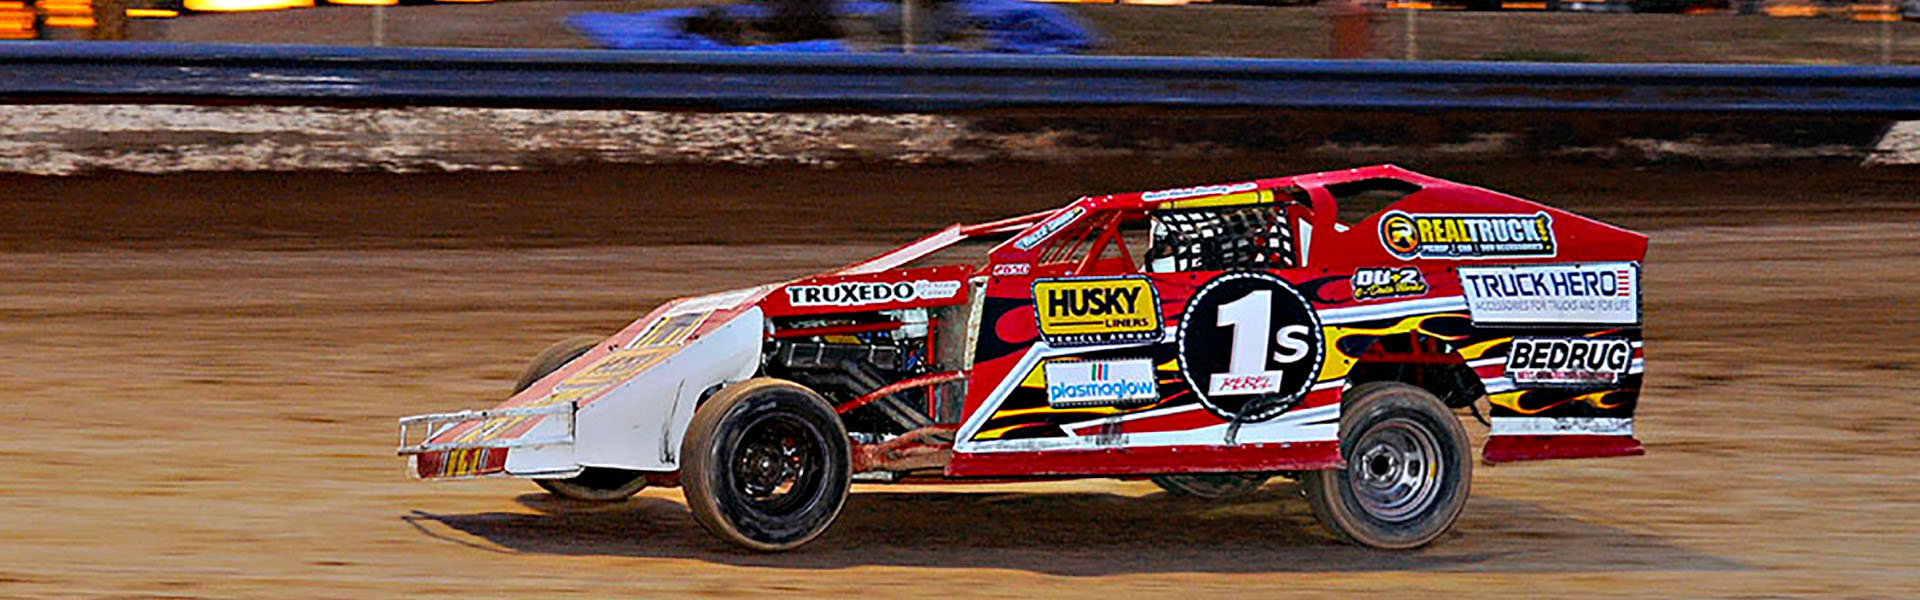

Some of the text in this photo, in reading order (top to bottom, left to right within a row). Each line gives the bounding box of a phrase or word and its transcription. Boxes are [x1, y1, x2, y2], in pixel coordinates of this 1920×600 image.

[789, 283, 914, 303] TRUXEDO
[1466, 271, 1616, 298] TRUCK HERO
[1048, 286, 1142, 317] HUSKY
[1105, 318, 1149, 328] LINERS
[1510, 342, 1626, 371] BEDRUG
[1051, 379, 1152, 401] plasmaglow
